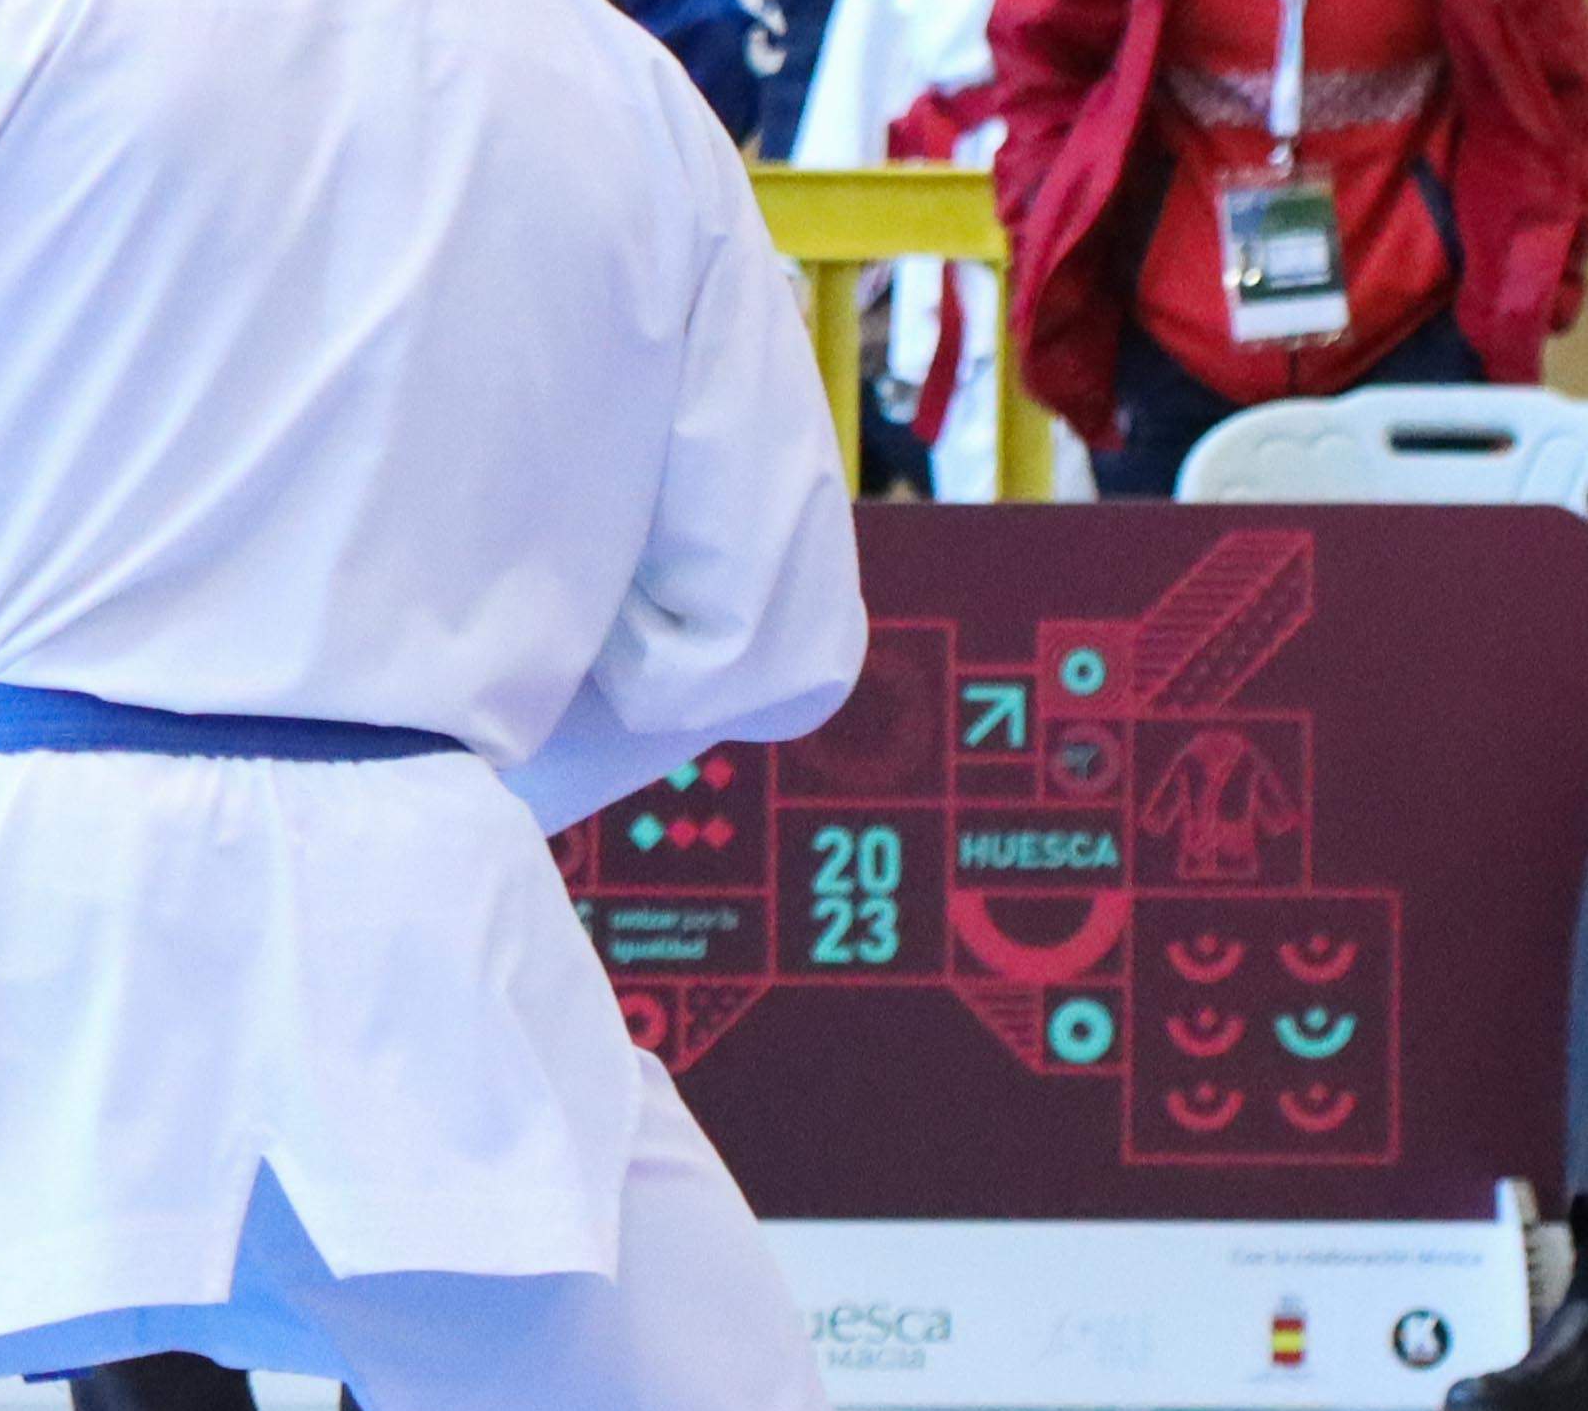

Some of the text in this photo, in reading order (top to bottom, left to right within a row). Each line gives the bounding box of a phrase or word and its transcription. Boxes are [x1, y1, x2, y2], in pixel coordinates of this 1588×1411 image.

[811, 824, 902, 895] 20
[958, 832, 1119, 870] HUESCA
[811, 895, 900, 964] 23
